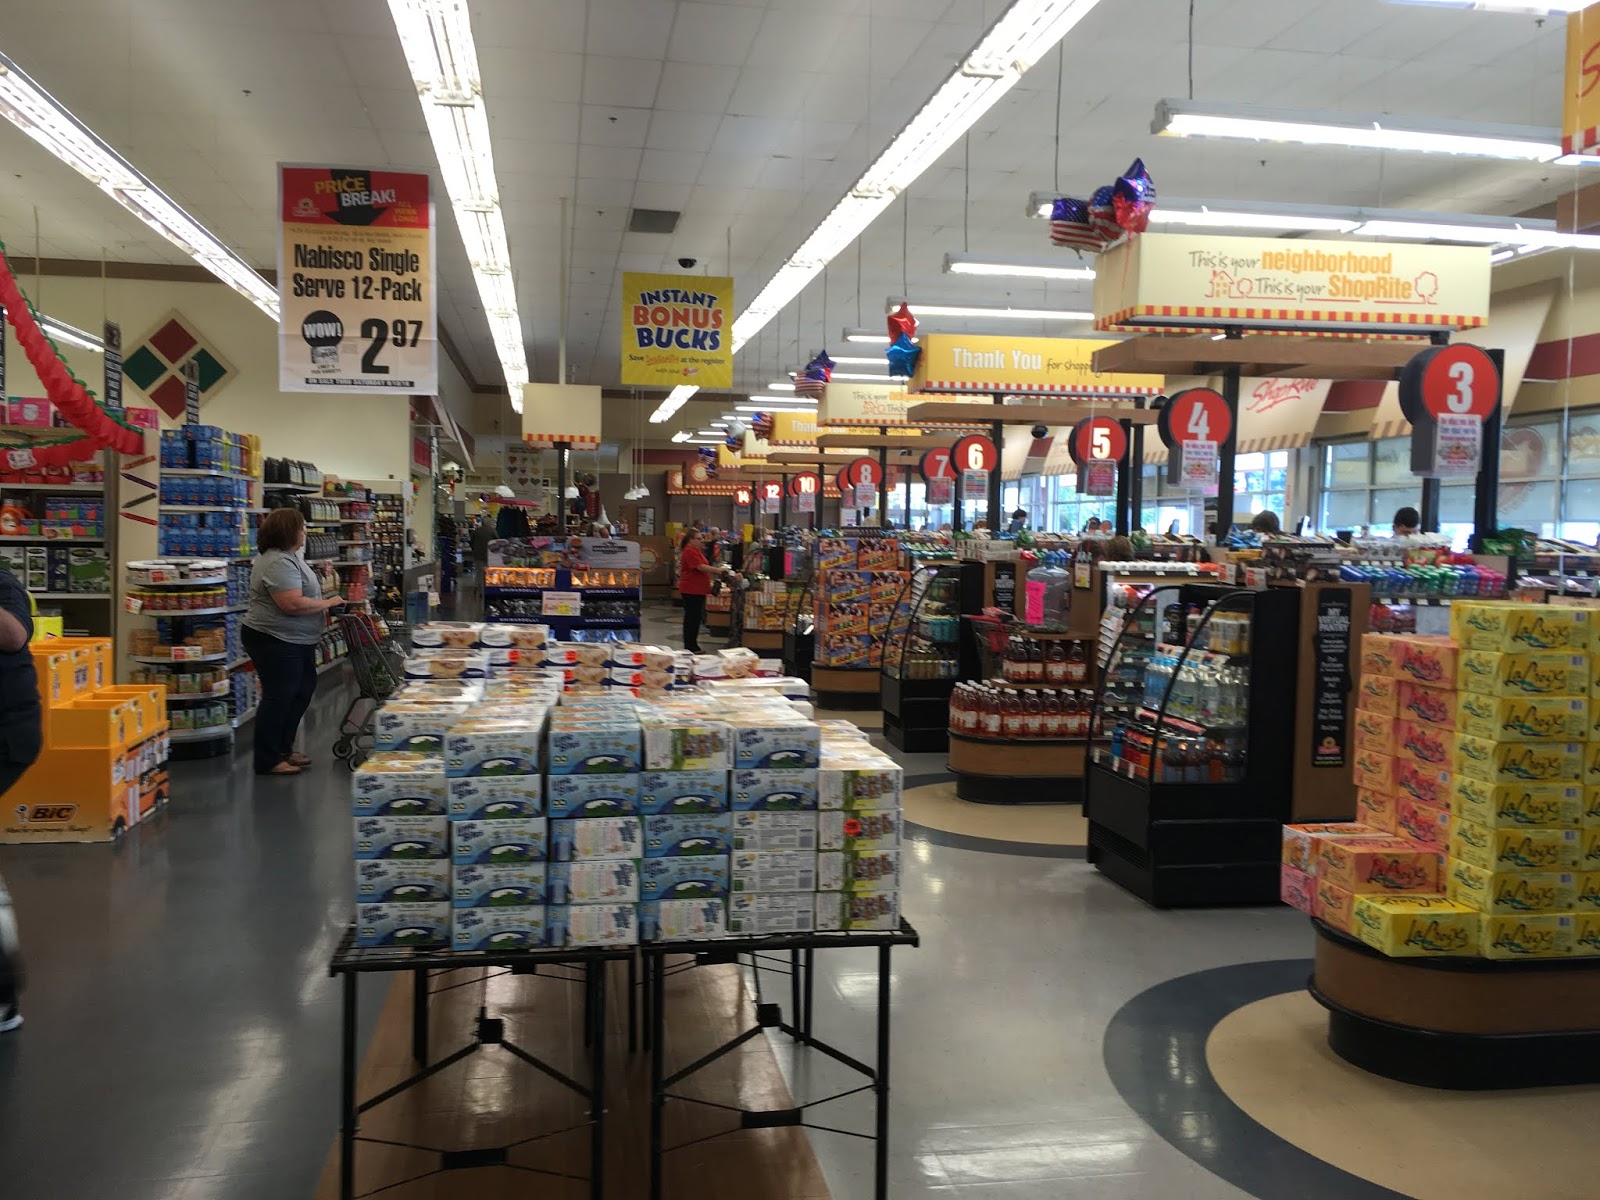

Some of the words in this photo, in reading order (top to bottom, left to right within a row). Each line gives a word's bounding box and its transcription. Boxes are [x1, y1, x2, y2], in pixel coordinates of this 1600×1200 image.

[341, 189, 396, 207] BREAK!
[294, 243, 363, 270] Nabisco
[369, 247, 419, 275] Single
[1189, 250, 1216, 268] This
[1218, 251, 1228, 268] is
[1231, 257, 1260, 277] your
[1261, 248, 1393, 274] neighborhood
[293, 273, 345, 298] Serve
[352, 275, 422, 301] 12-Pack
[640, 289, 717, 308] INSTANT
[1255, 277, 1282, 295] This
[1284, 278, 1294, 295] is
[1296, 284, 1326, 303] your
[1328, 274, 1412, 300] ShopRite
[633, 305, 723, 329] BONUS
[303, 322, 342, 338] WOW!
[361, 318, 390, 375] 2
[392, 320, 423, 348] 97
[636, 327, 720, 351] BUCKS
[953, 347, 1005, 370] Thank
[1012, 349, 1042, 370] You
[1064, 359, 1101, 378] shopp
[1446, 361, 1474, 414] 3
[1187, 402, 1210, 441] 4
[968, 443, 984, 469] 6
[1092, 427, 1111, 459] 5
[860, 465, 871, 483] 8
[935, 455, 949, 478] 7
[765, 483, 780, 498] 12
[799, 476, 815, 493] 10
